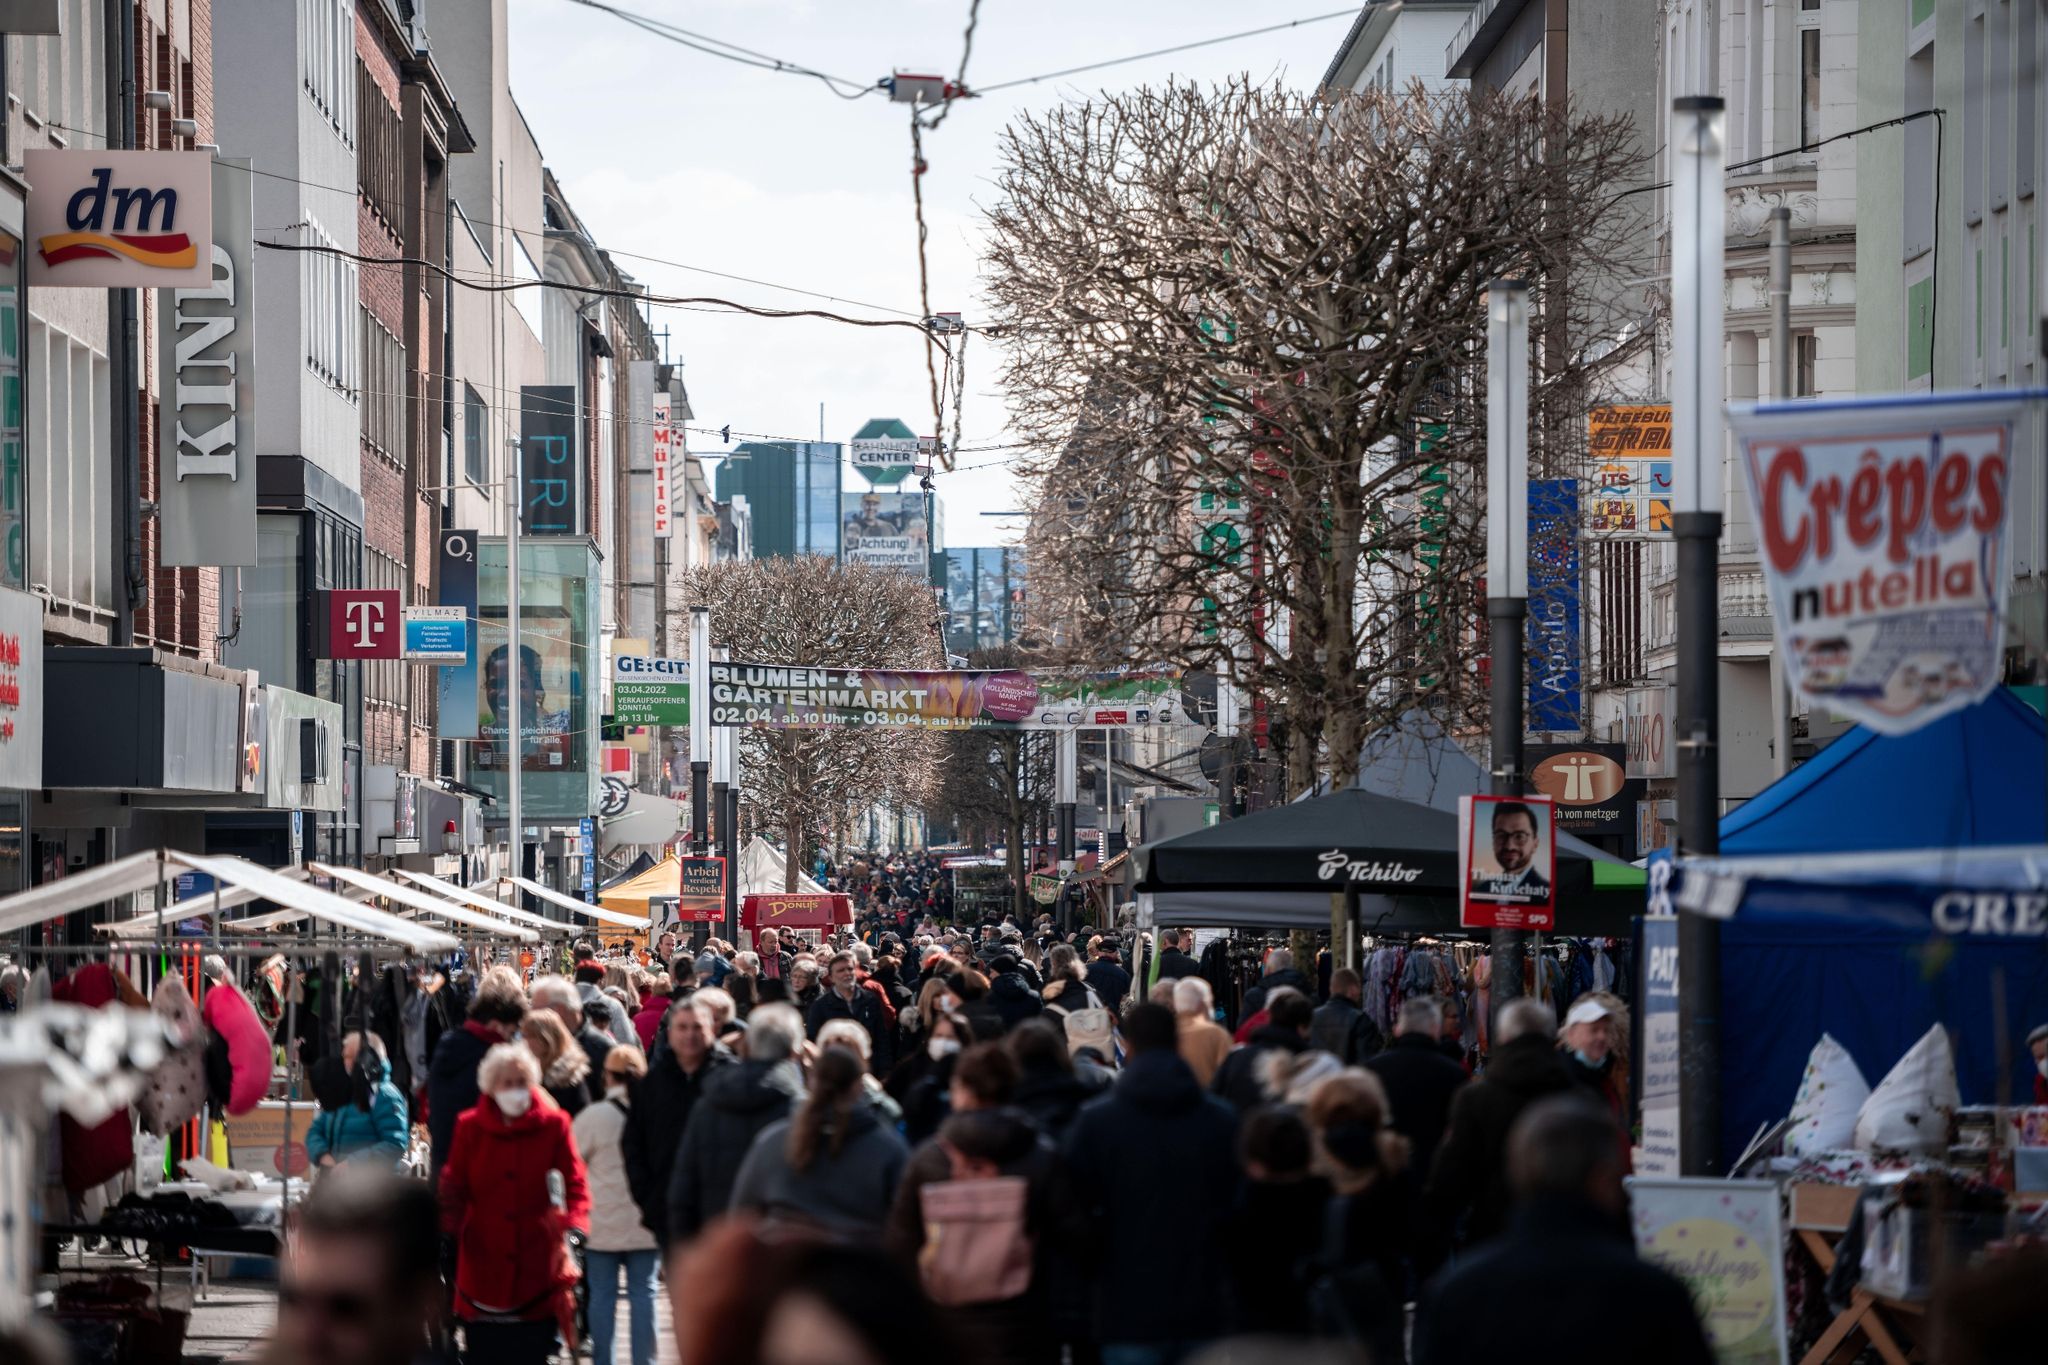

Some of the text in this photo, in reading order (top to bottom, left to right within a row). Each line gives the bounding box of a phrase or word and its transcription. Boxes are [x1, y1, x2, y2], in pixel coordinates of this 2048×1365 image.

[65, 168, 178, 232] dm
[174, 243, 237, 482] KIND
[860, 452, 911, 462] CENTER
[654, 429, 669, 531] Müller
[1601, 473, 1630, 487] ITS
[1761, 446, 2007, 574] Crêpes
[860, 538, 910, 550] Achtung!
[1791, 555, 1976, 623] nutella
[1540, 601, 1572, 693] Apollo
[711, 666, 863, 689] BLUMEN- &
[617, 686, 667, 694] 03.04.2022
[712, 683, 928, 710] GARTENMARKT
[985, 684, 1037, 698] HOLLÄNDISCHER
[998, 693, 1022, 701] MARKT
[617, 714, 660, 722] ab 13 Uhr
[712, 706, 778, 724] 02.04.
[782, 713, 799, 724] ab
[803, 713, 819, 724] 10
[820, 713, 848, 724] Uhr
[863, 710, 927, 725] 03.04.
[931, 716, 949, 726] ab
[952, 717, 968, 726] 11
[968, 717, 995, 726] Uhr
[1564, 811, 1582, 819] vom
[1584, 808, 1620, 821] metzger
[685, 866, 719, 877] Arbeit
[1347, 861, 1424, 883] Tchibo
[1528, 913, 1548, 924] SPD
